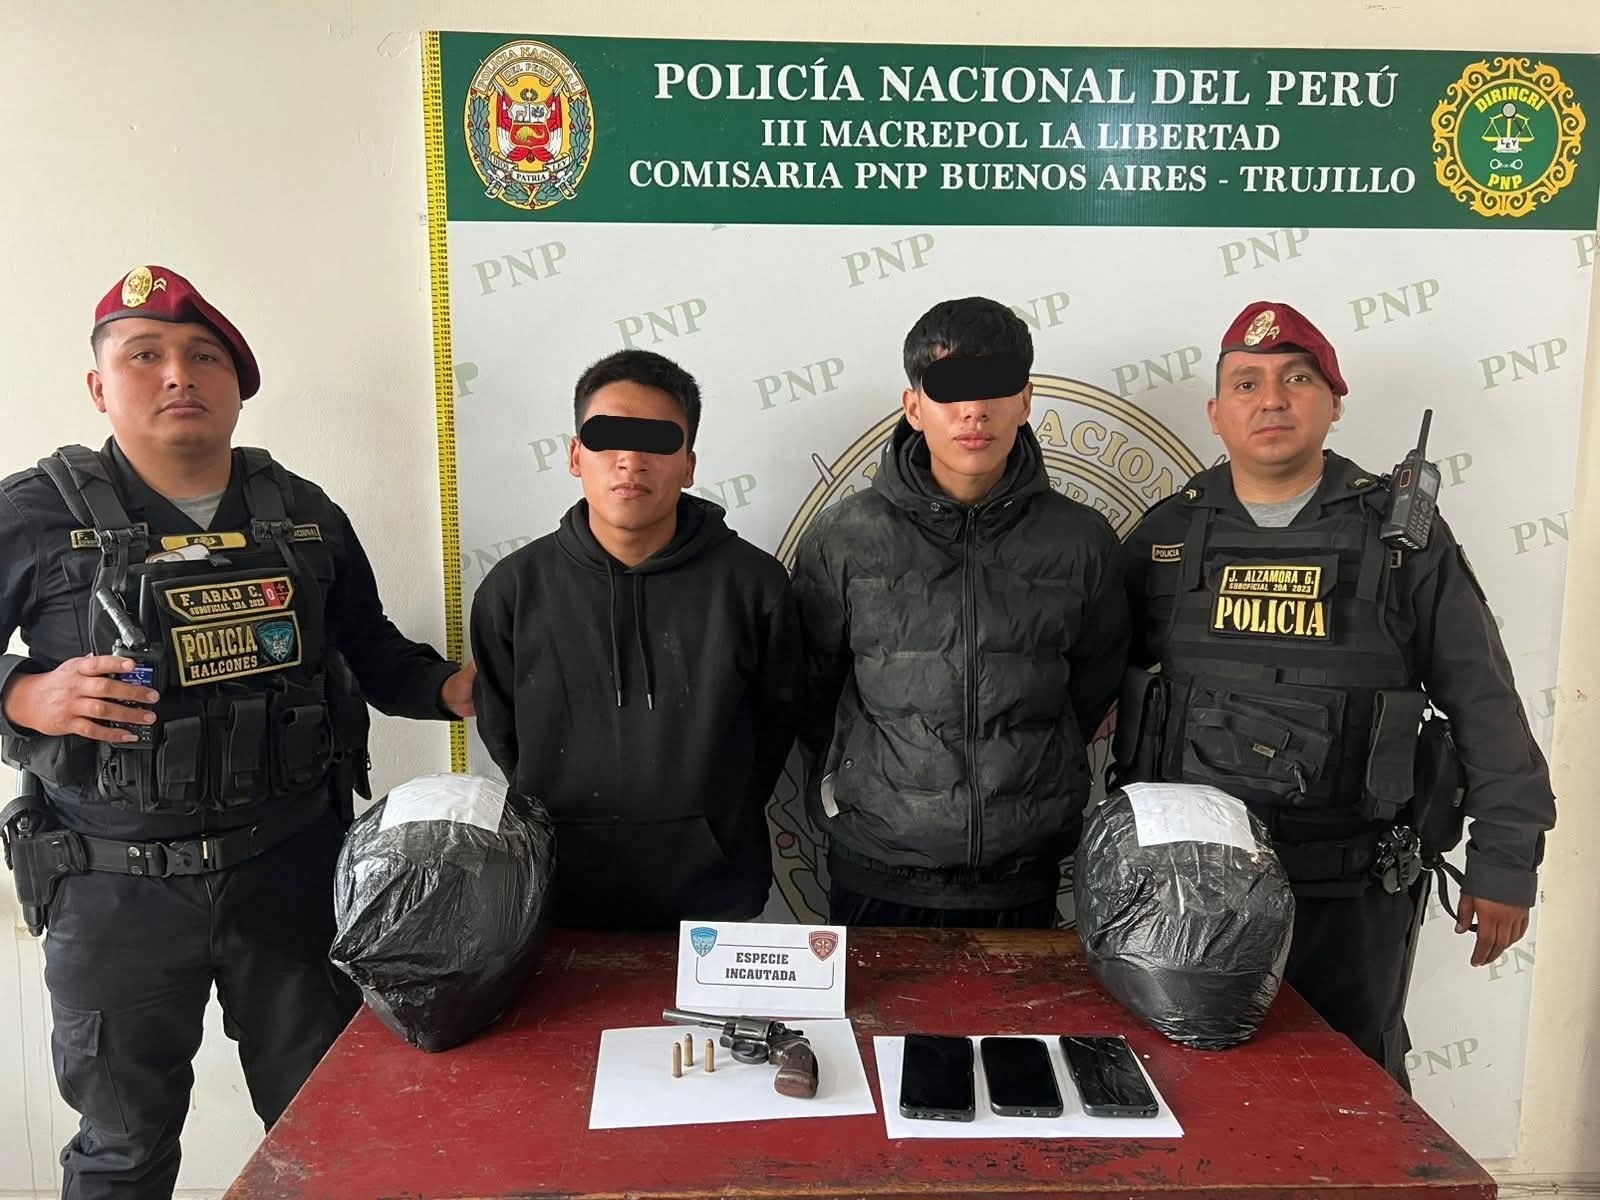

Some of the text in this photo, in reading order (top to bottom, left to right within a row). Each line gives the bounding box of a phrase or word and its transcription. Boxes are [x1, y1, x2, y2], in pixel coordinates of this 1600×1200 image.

[654, 58, 1399, 108] POLICÍA NACIONAL DEL PERÚ
[1473, 86, 1547, 113] DIRINCRI
[761, 119, 1280, 151] III MACREPOL LA LIBERTAD
[1500, 139, 1517, 149] LEY
[516, 173, 547, 183] PATRIA
[629, 160, 843, 189] COMISARIA
[855, 163, 928, 189] PNP
[940, 163, 1087, 191] BUENOS
[1097, 164, 1207, 192] AIRES
[1239, 166, 1416, 194] TRUJILLO
[1487, 173, 1523, 190] PNP
[472, 241, 567, 296] PNP
[841, 233, 935, 289] PNP
[1349, 278, 1440, 332] PNP
[614, 298, 708, 350] PNP
[1111, 345, 1203, 398] PNP
[1478, 336, 1568, 391] PNP
[752, 357, 845, 411] PNP
[1244, 570, 1299, 584] ALZAMORA
[201, 587, 243, 604] ABAD
[1213, 596, 1326, 637] POLICIA
[180, 624, 259, 663] POLICIA
[189, 655, 259, 680] HALCONES
[725, 967, 797, 982] INCAUTADA
[735, 952, 790, 965] ESPECIE
